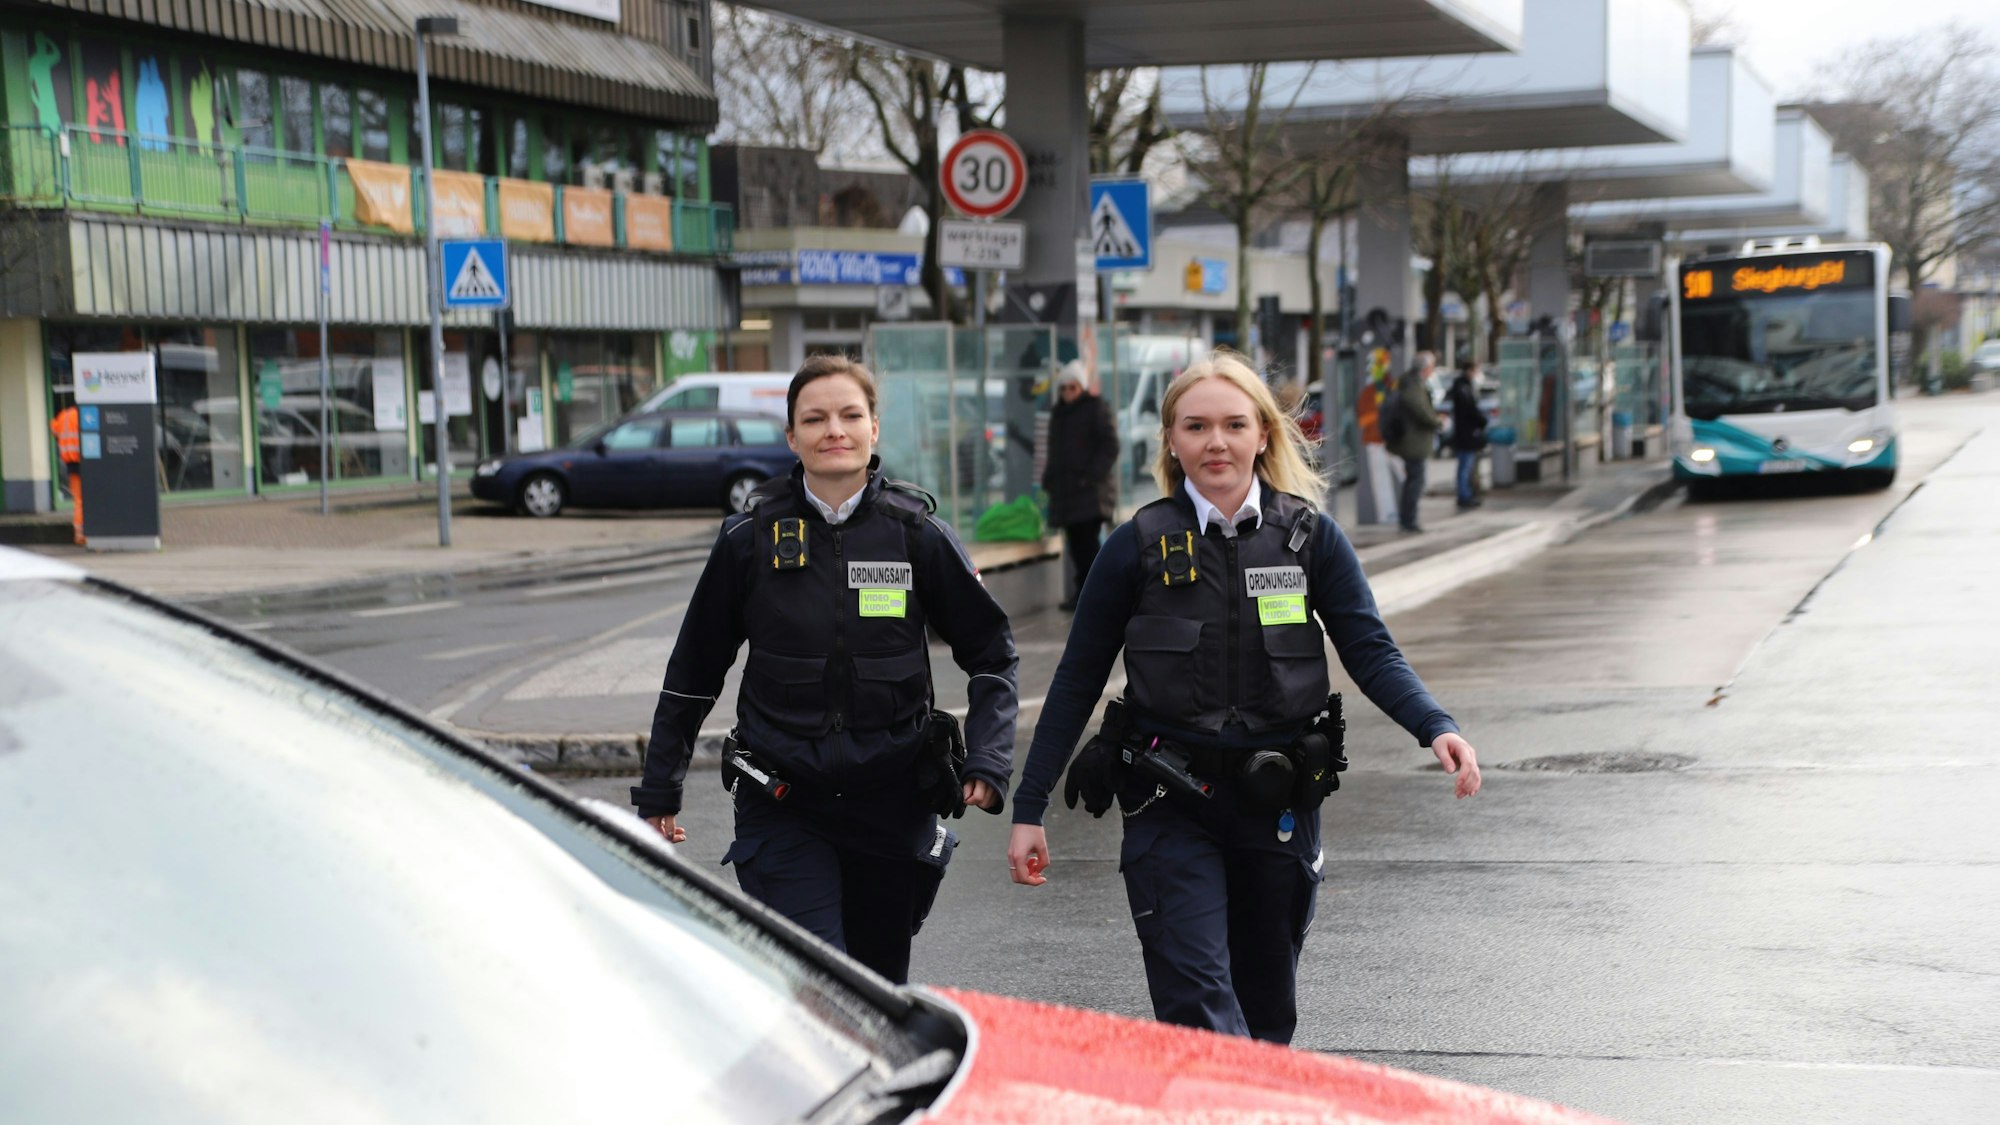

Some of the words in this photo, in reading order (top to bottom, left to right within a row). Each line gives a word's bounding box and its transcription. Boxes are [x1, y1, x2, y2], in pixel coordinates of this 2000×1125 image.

[960, 155, 1007, 194] 30
[850, 567, 911, 584] ORDNUNGSAMT
[1248, 571, 1307, 591] ORDNUNGSAMT
[863, 593, 890, 602] VIDEO
[863, 603, 890, 612] AUDIO
[1263, 599, 1289, 610] VIDEO
[1264, 609, 1291, 619] AUDIO
